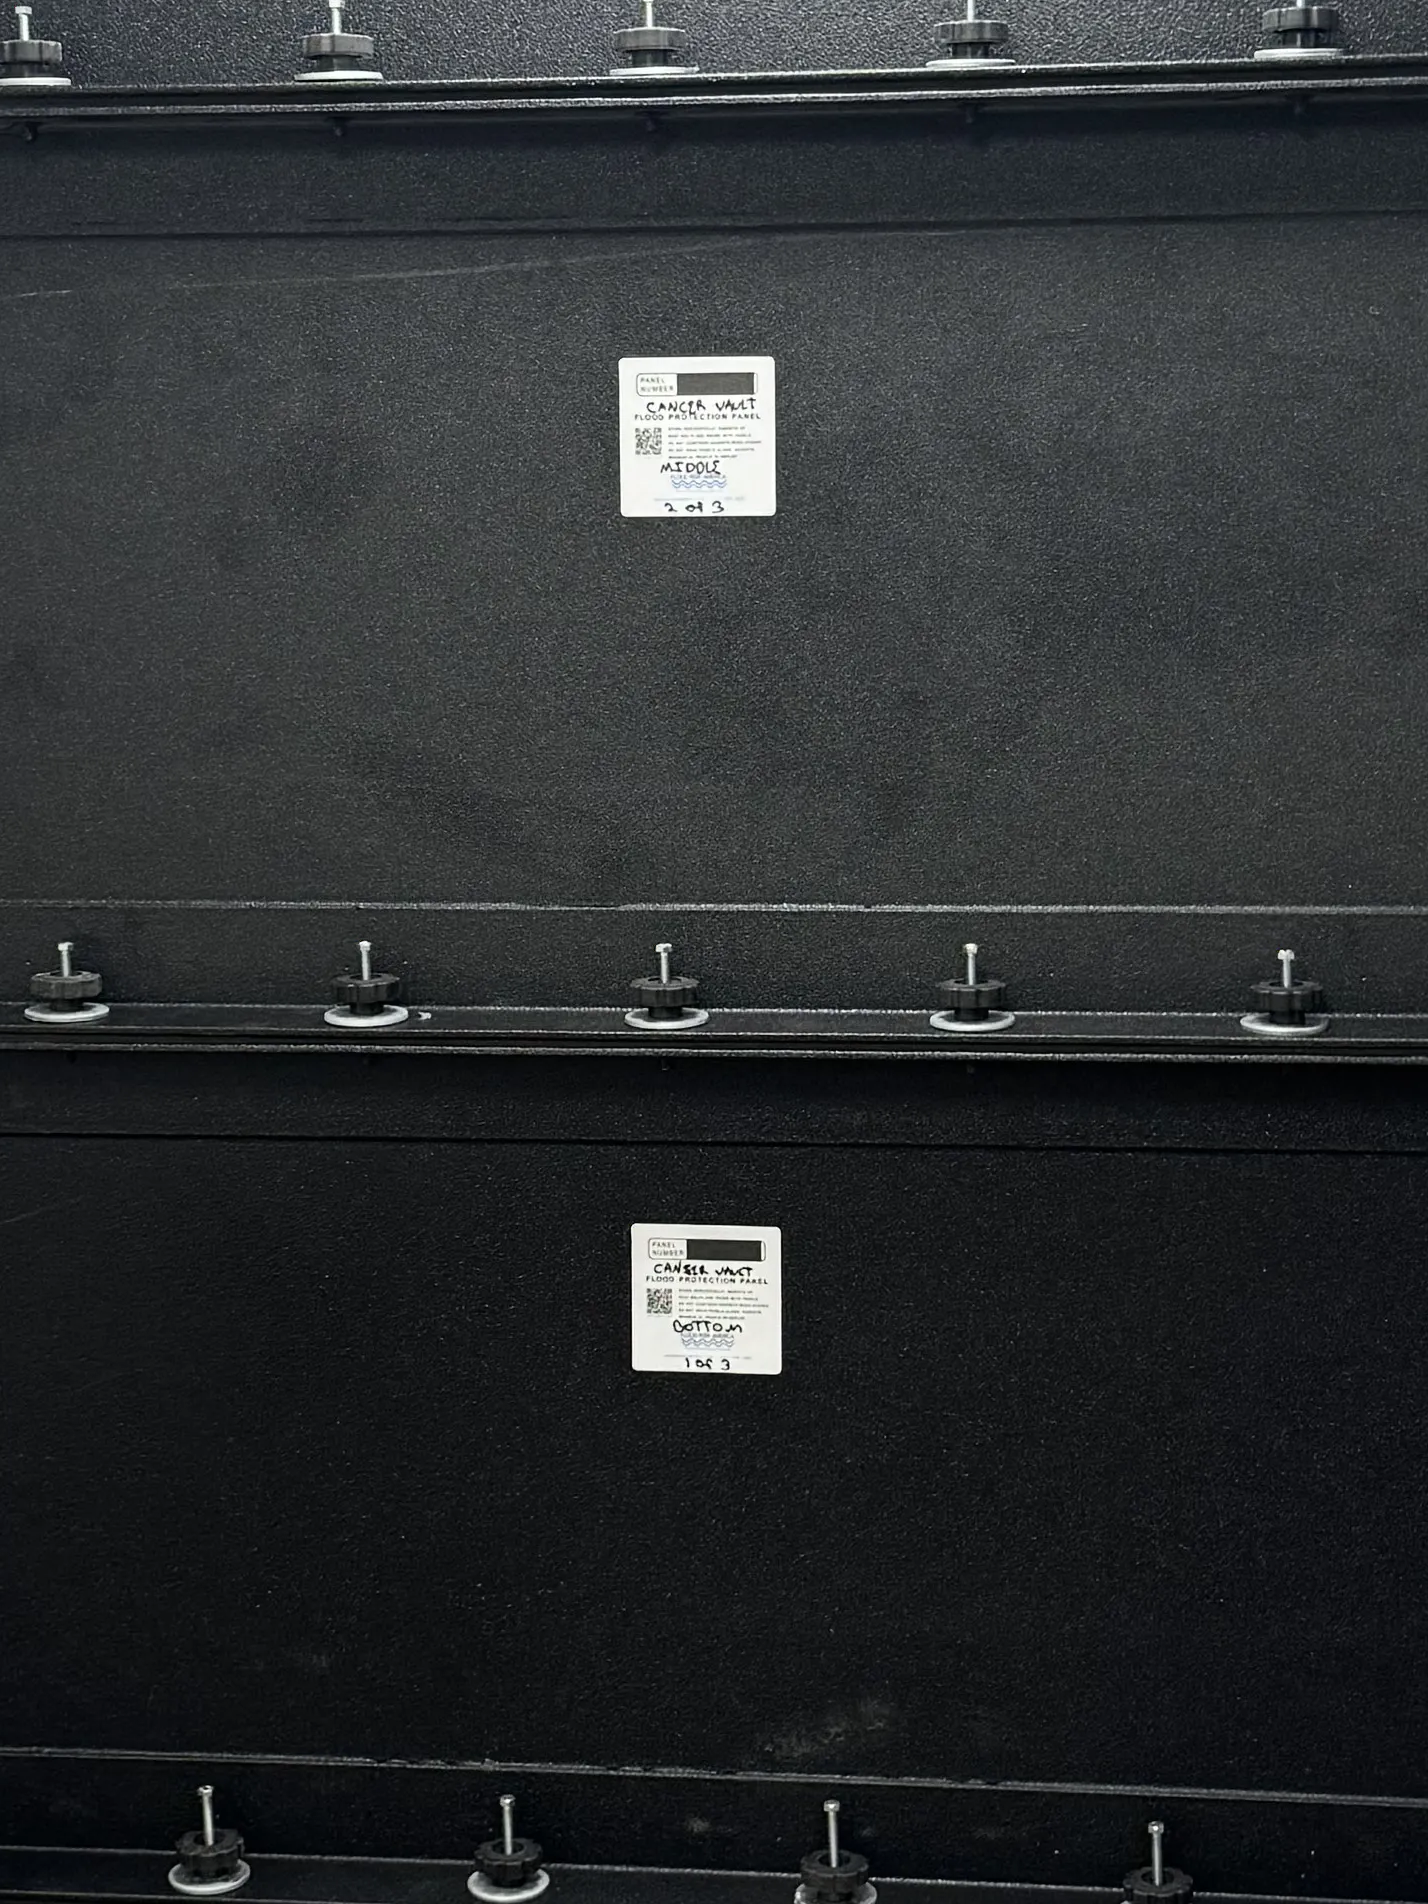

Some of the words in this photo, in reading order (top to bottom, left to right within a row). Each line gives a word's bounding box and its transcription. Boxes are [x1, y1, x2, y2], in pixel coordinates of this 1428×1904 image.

[646, 399, 706, 416] CANCER
[634, 413, 665, 421] FLOOD
[668, 412, 728, 421] PROTECTION
[731, 412, 762, 420] PANEL
[660, 460, 721, 475] MIDDLE
[664, 502, 677, 513] 2
[685, 501, 703, 513] of
[712, 500, 725, 513] 3
[646, 1275, 675, 1283] FLOOD
[678, 1276, 736, 1285] PROTECTION
[739, 1277, 769, 1285] PANEL
[720, 1358, 731, 1371] 3
